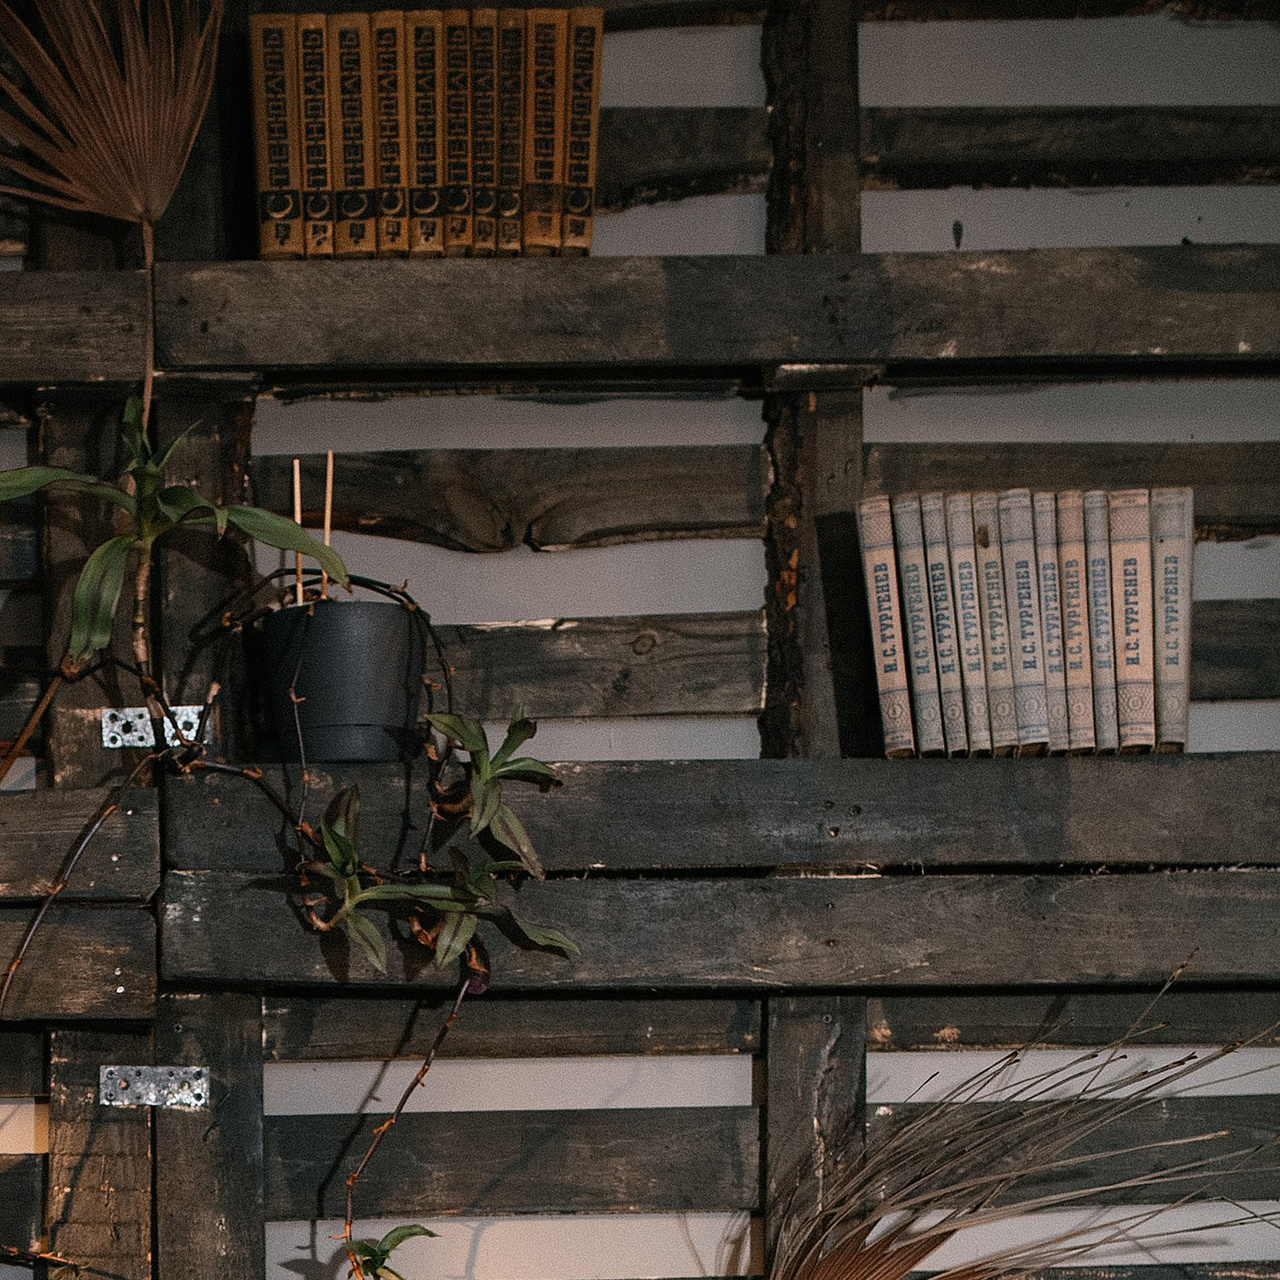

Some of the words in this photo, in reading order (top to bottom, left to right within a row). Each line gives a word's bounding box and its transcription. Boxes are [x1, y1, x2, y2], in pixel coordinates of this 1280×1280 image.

[303, 28, 331, 218] СТЕНДАЛЬ
[339, 28, 368, 218] СТЕНДАЛЬ
[412, 26, 440, 215] СТЕНДАЛЬ
